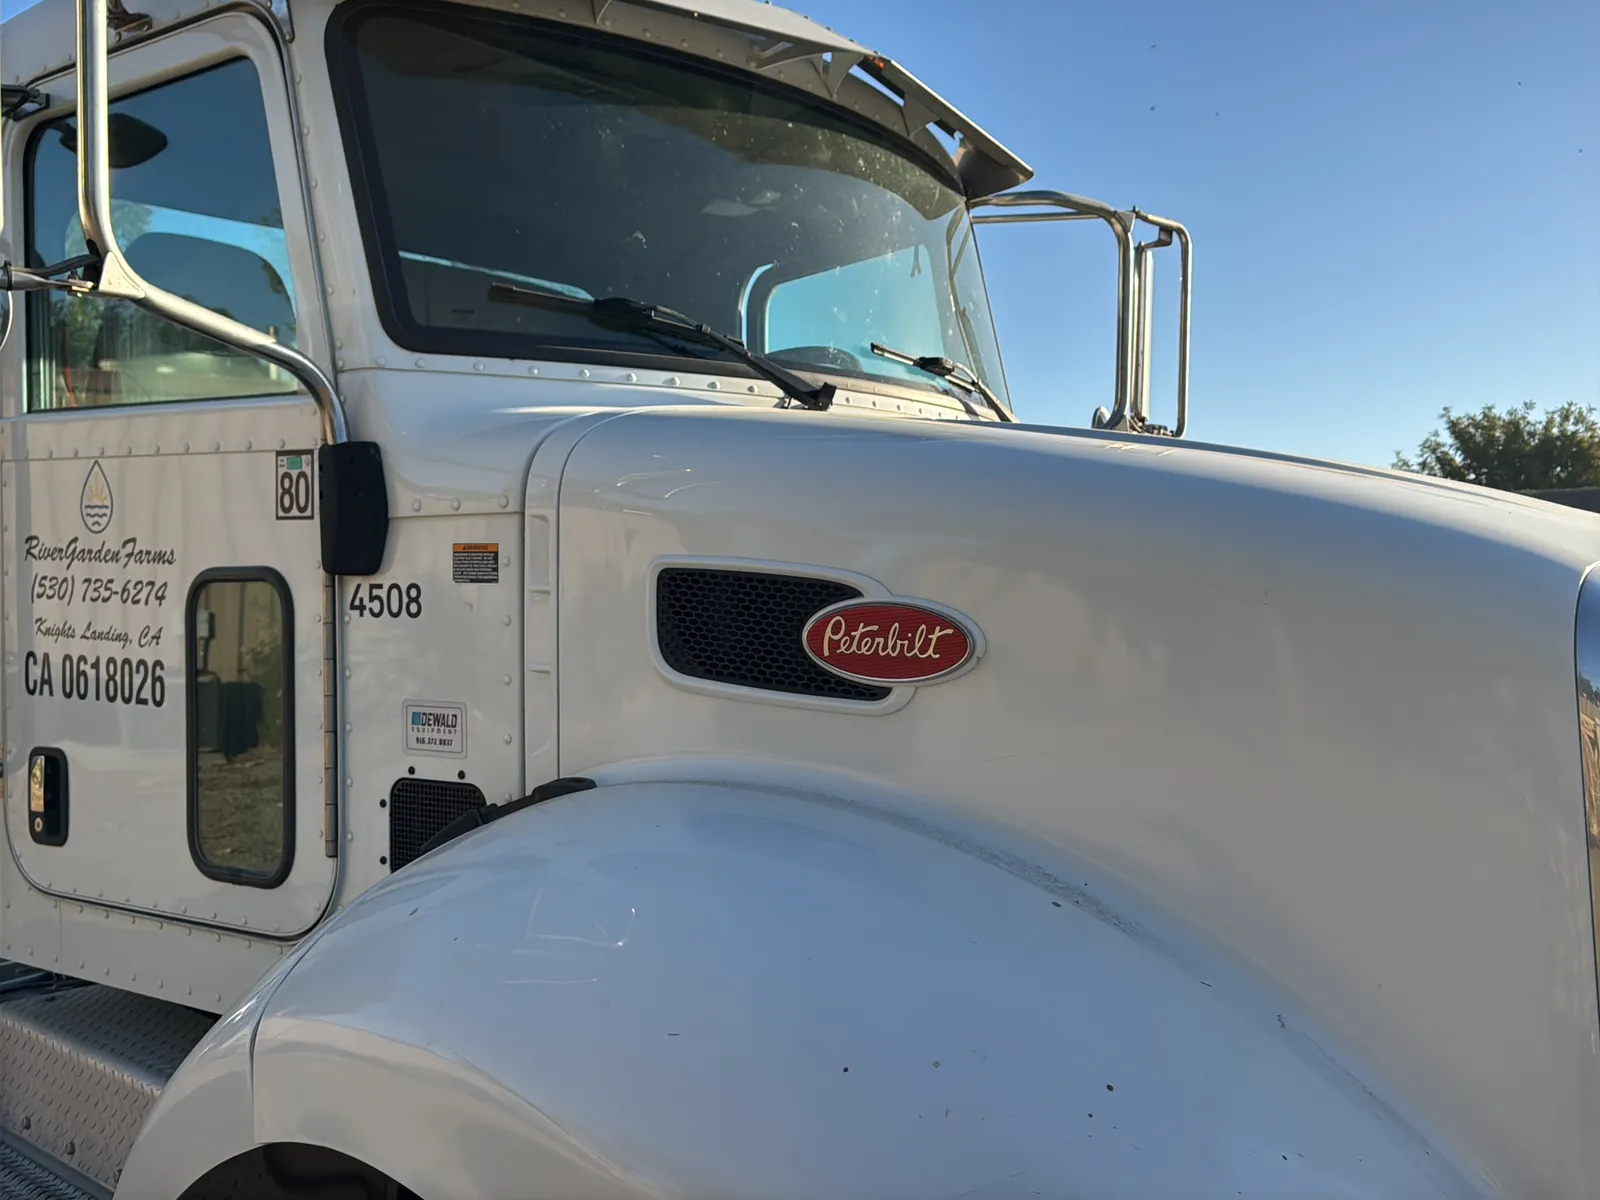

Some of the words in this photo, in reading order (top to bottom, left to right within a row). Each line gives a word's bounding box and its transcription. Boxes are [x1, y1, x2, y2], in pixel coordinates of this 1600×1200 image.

[280, 471, 310, 514] 80
[31, 573, 75, 606] (530)
[81, 577, 168, 607] 735-6274
[349, 582, 422, 619] 4508
[35, 617, 77, 644] Knights
[80, 621, 133, 650] Landing,
[138, 625, 164, 648] CA
[823, 615, 954, 659] Peterbilt
[25, 650, 54, 697] CA
[61, 653, 166, 708] 0618026
[421, 712, 458, 729] DEWALD
